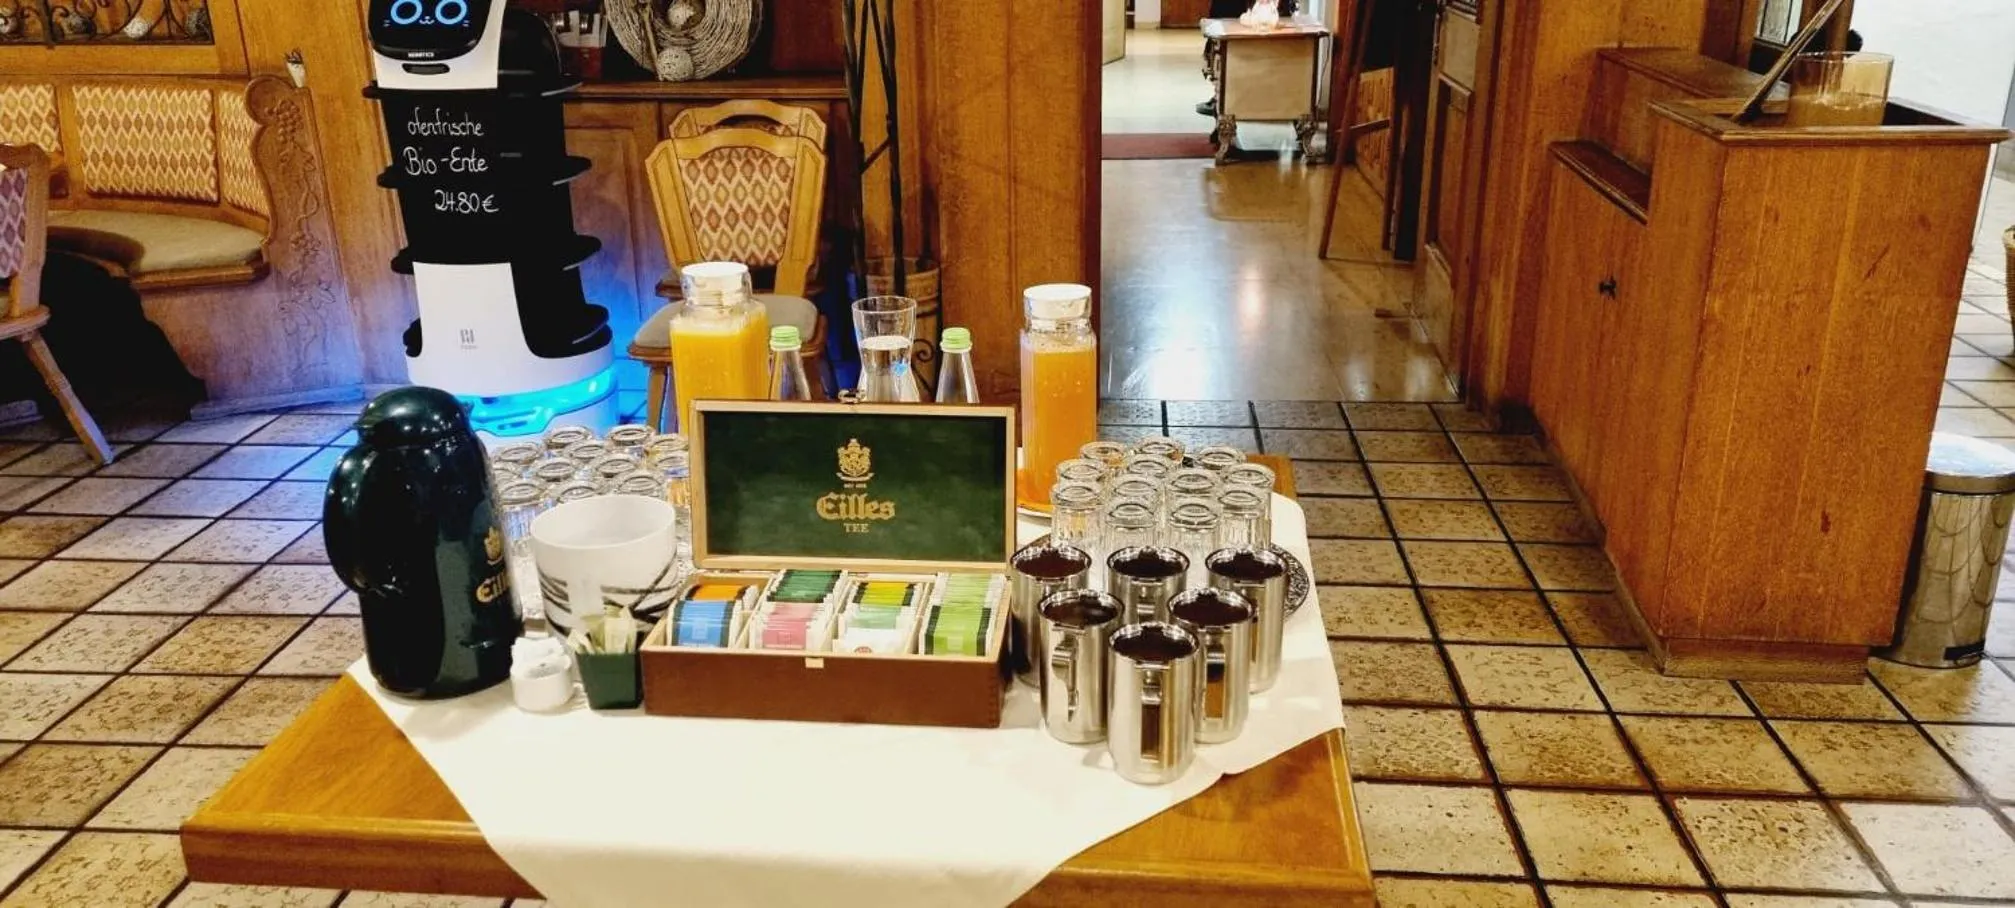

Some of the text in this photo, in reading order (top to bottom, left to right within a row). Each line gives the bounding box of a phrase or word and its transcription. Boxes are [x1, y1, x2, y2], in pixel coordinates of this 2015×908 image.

[407, 106, 485, 136] ofenfrische
[816, 491, 896, 520] Eilles
[843, 522, 870, 533] TEE
